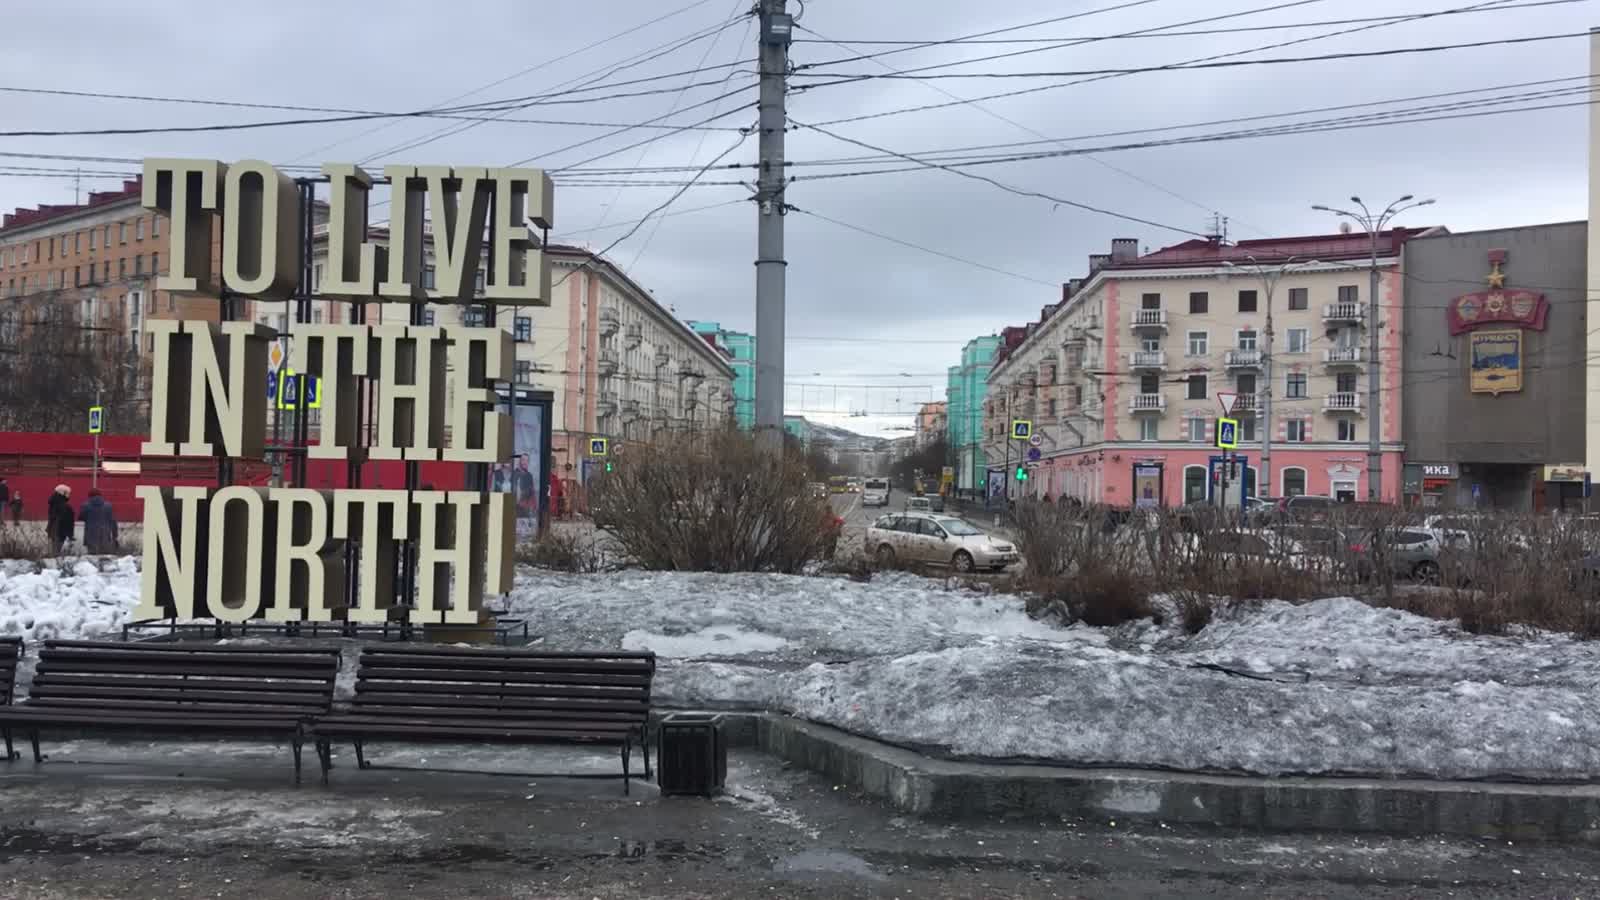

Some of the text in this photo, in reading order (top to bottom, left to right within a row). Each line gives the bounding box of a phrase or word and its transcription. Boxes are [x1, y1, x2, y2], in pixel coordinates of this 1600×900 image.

[143, 158, 546, 301] TO LIVE
[141, 320, 504, 463] IN THE
